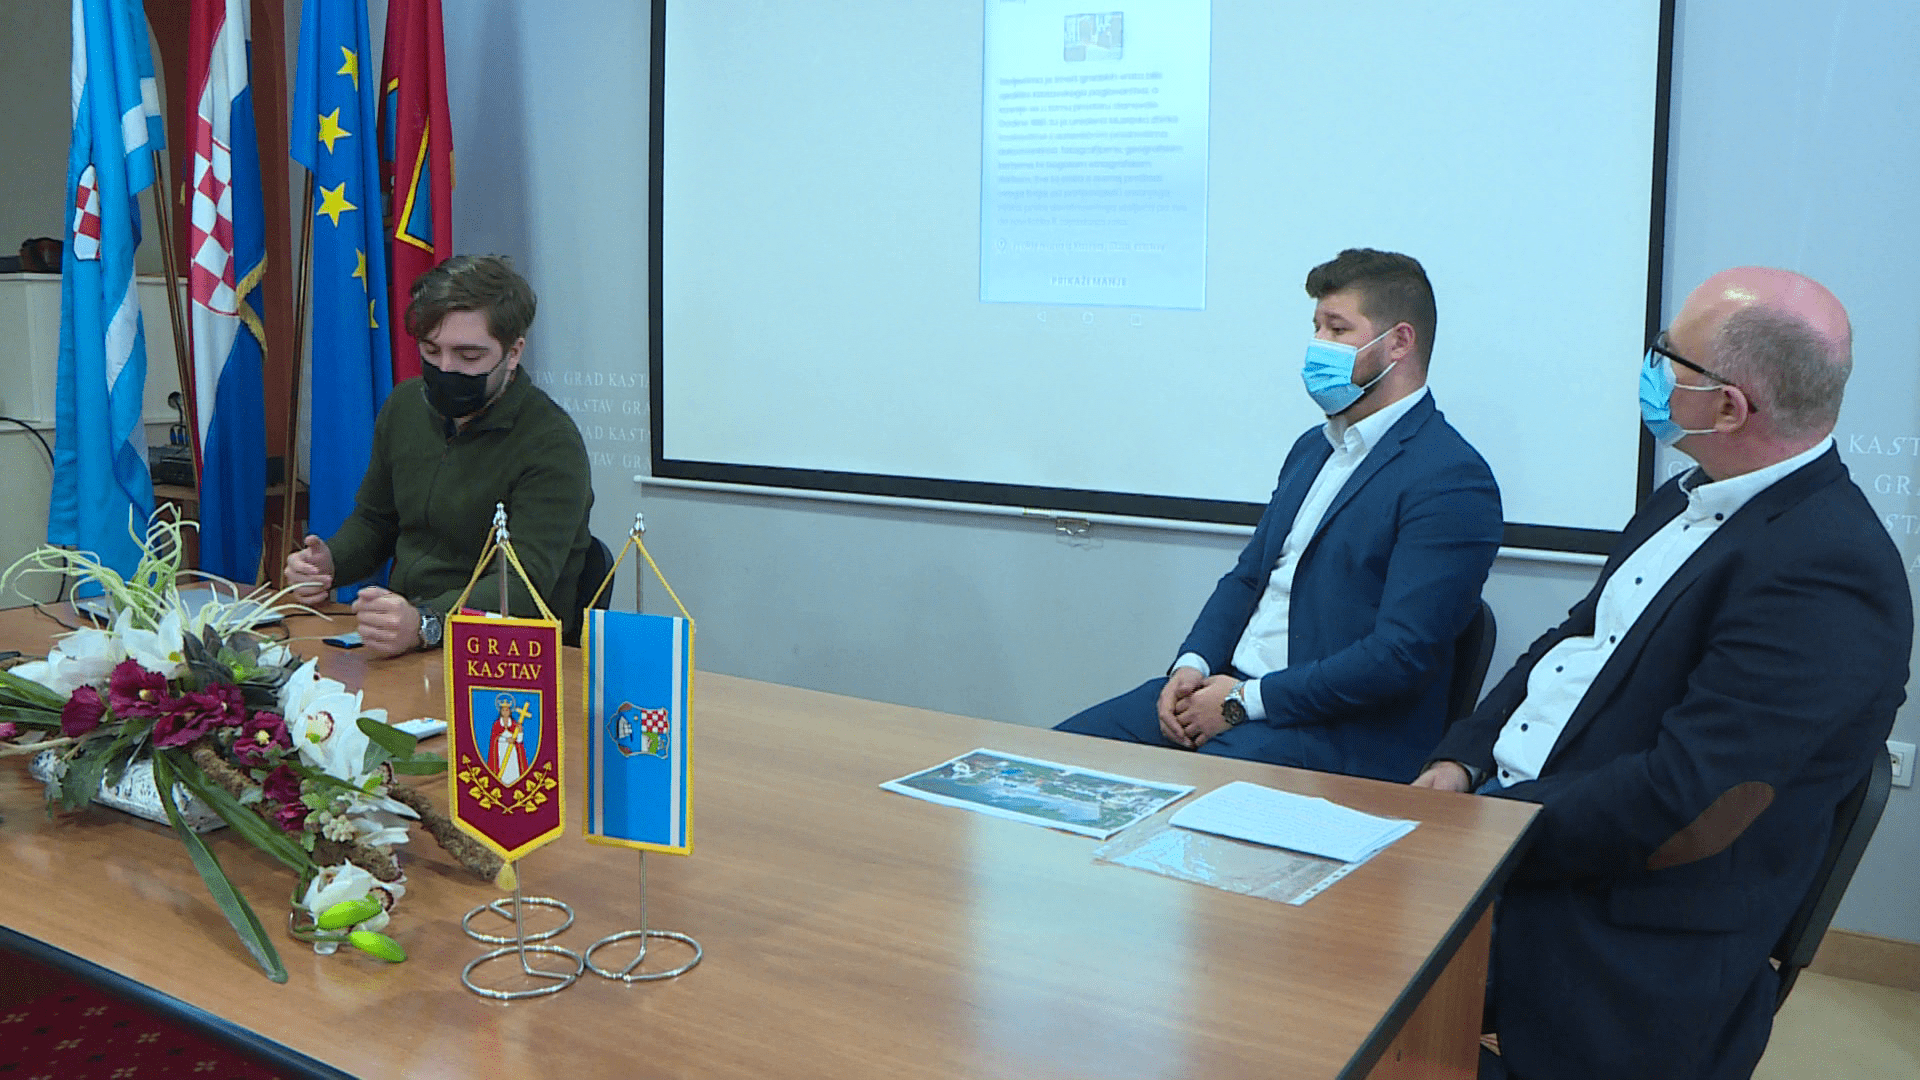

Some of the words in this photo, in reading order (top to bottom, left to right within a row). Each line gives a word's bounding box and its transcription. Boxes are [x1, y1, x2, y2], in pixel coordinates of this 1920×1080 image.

[564, 371, 603, 386] GRAD
[1874, 473, 1920, 496] GR
[467, 637, 542, 657] GRAD
[467, 659, 542, 680] KASTAV
